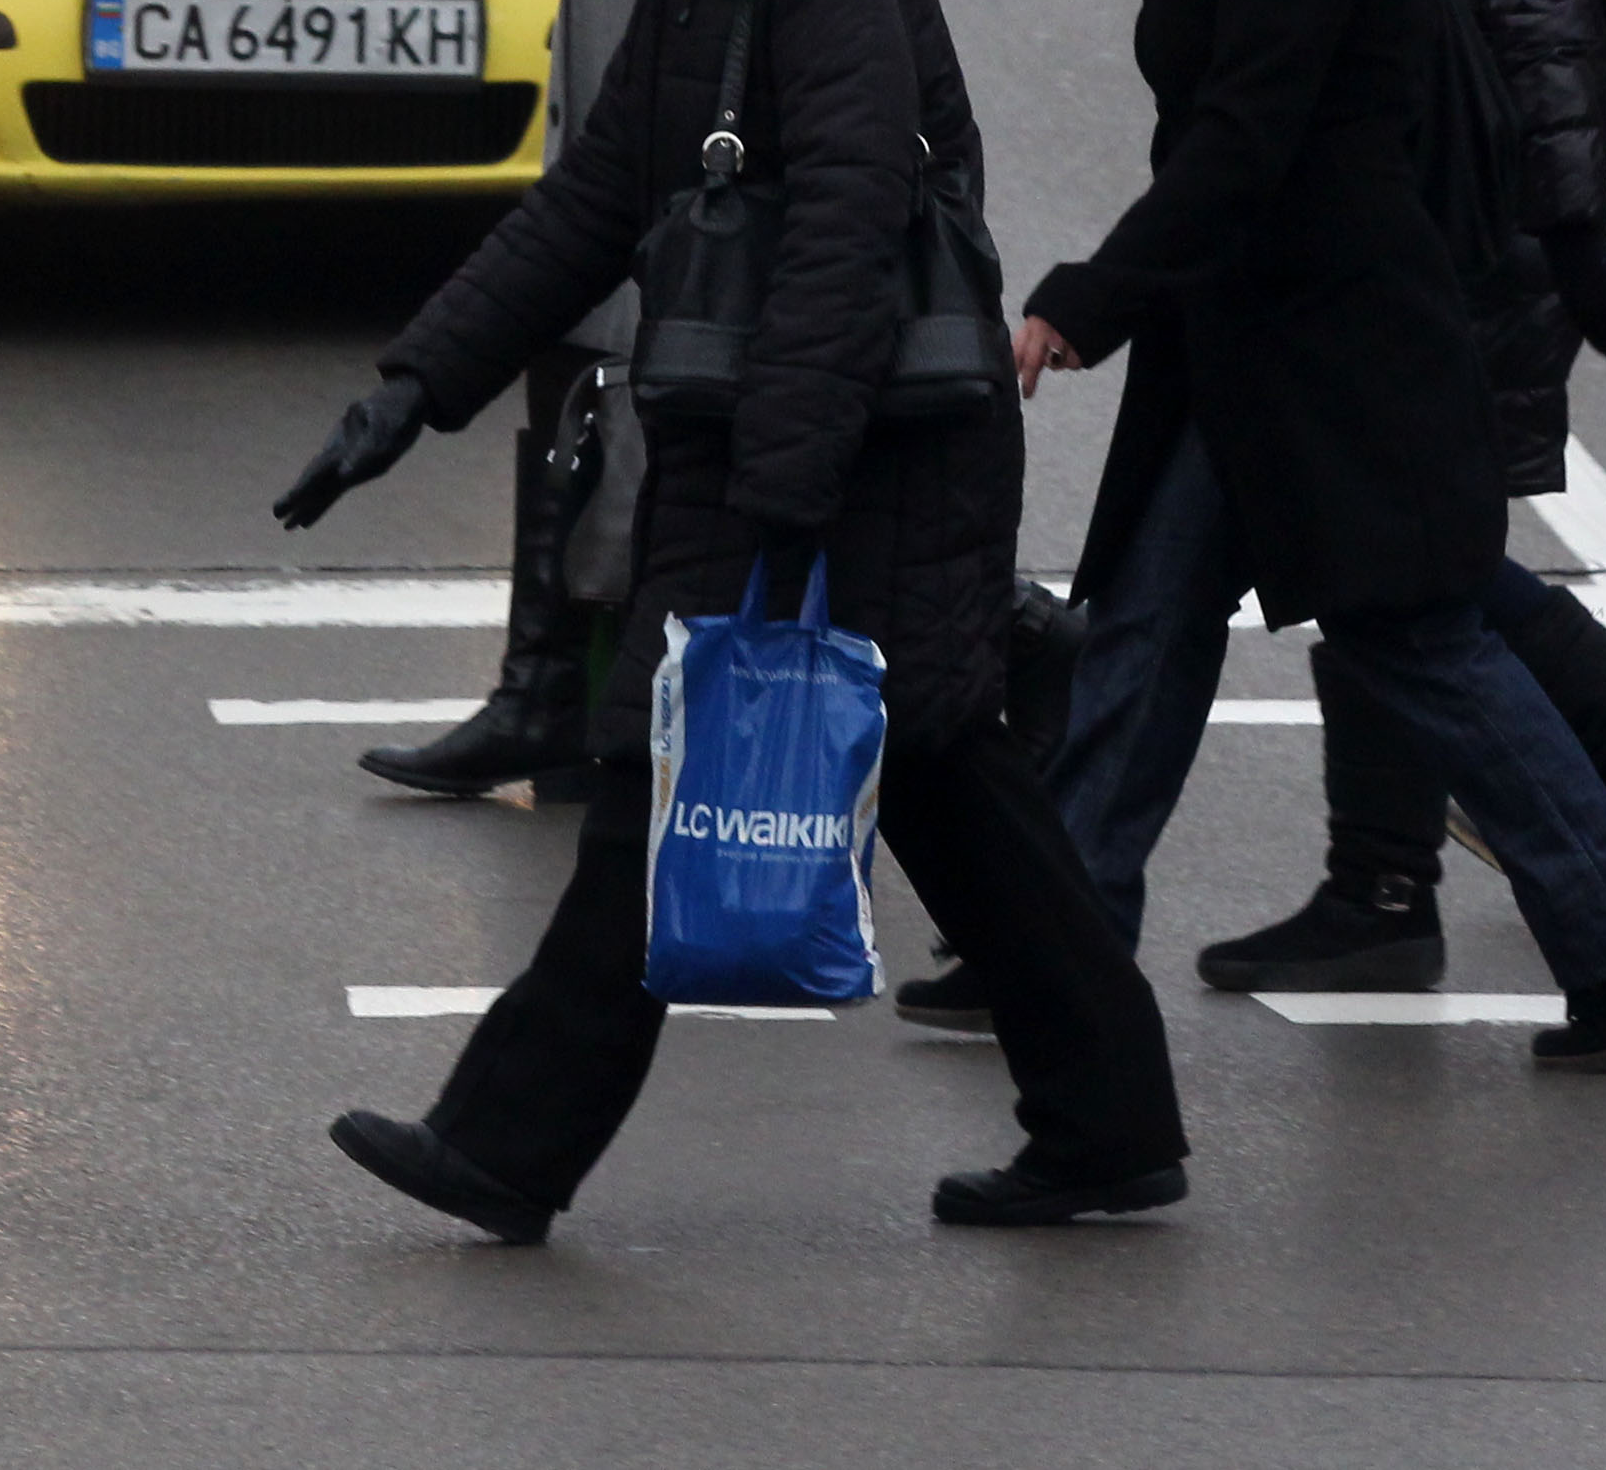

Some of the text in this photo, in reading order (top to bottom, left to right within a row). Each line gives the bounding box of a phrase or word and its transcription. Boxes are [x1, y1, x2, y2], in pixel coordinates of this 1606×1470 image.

[133, 3, 467, 66] CA 6491 KH
[674, 800, 713, 840] LC
